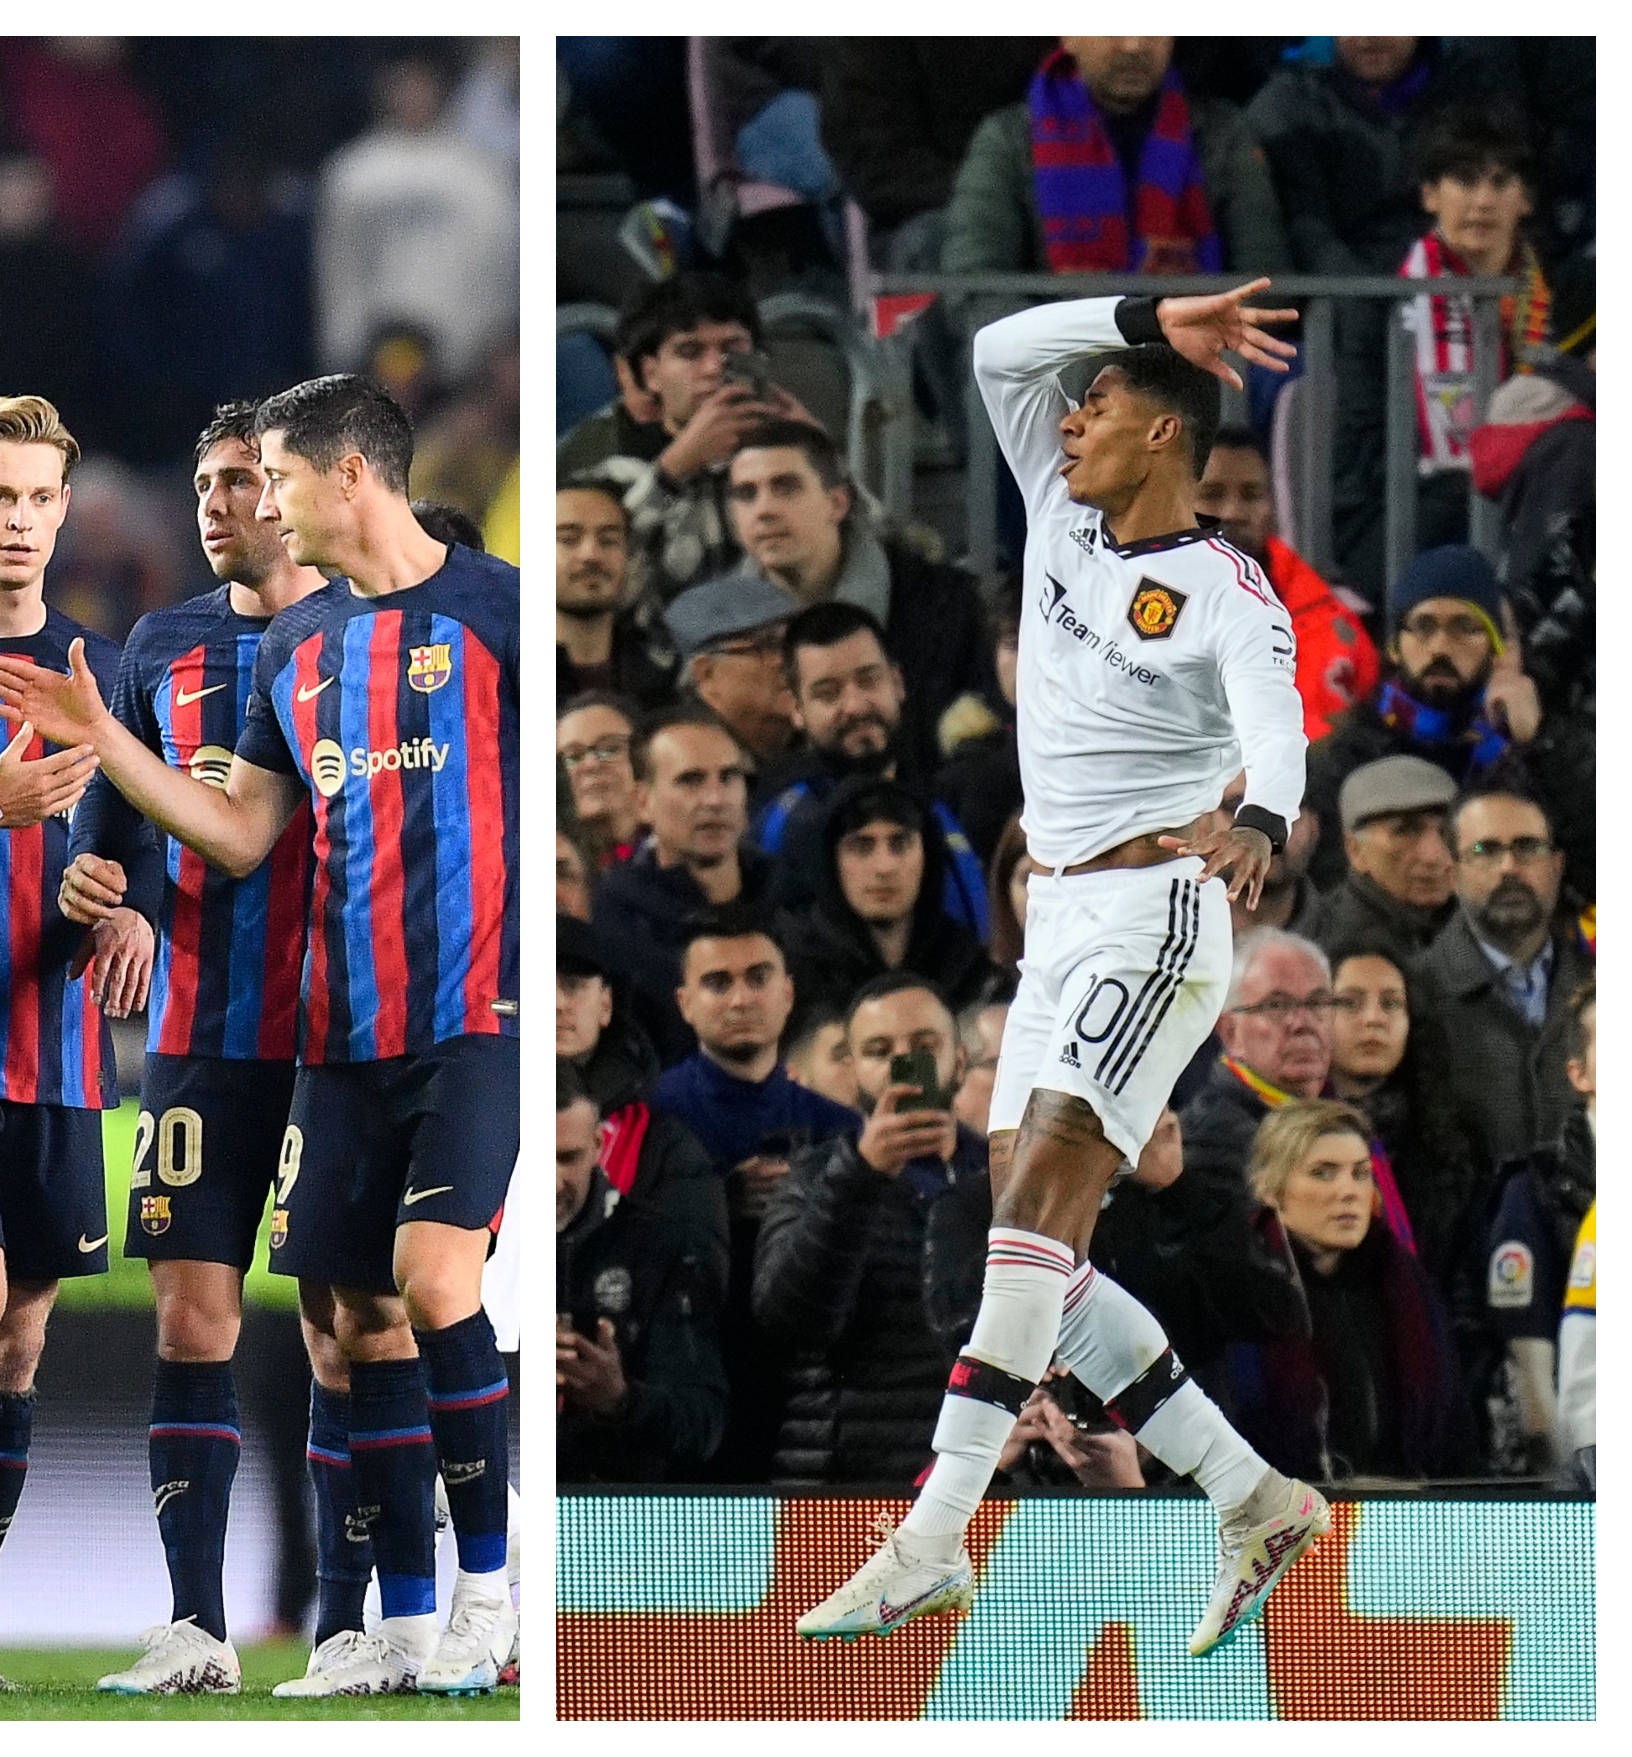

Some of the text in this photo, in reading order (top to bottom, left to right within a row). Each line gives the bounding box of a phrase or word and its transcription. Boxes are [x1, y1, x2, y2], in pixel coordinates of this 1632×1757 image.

[1055, 604, 1161, 686] TeamViewer
[350, 737, 450, 780] Spotify
[1062, 972, 1129, 1044] 10
[131, 1106, 203, 1190] 20
[276, 1124, 304, 1205] 9
